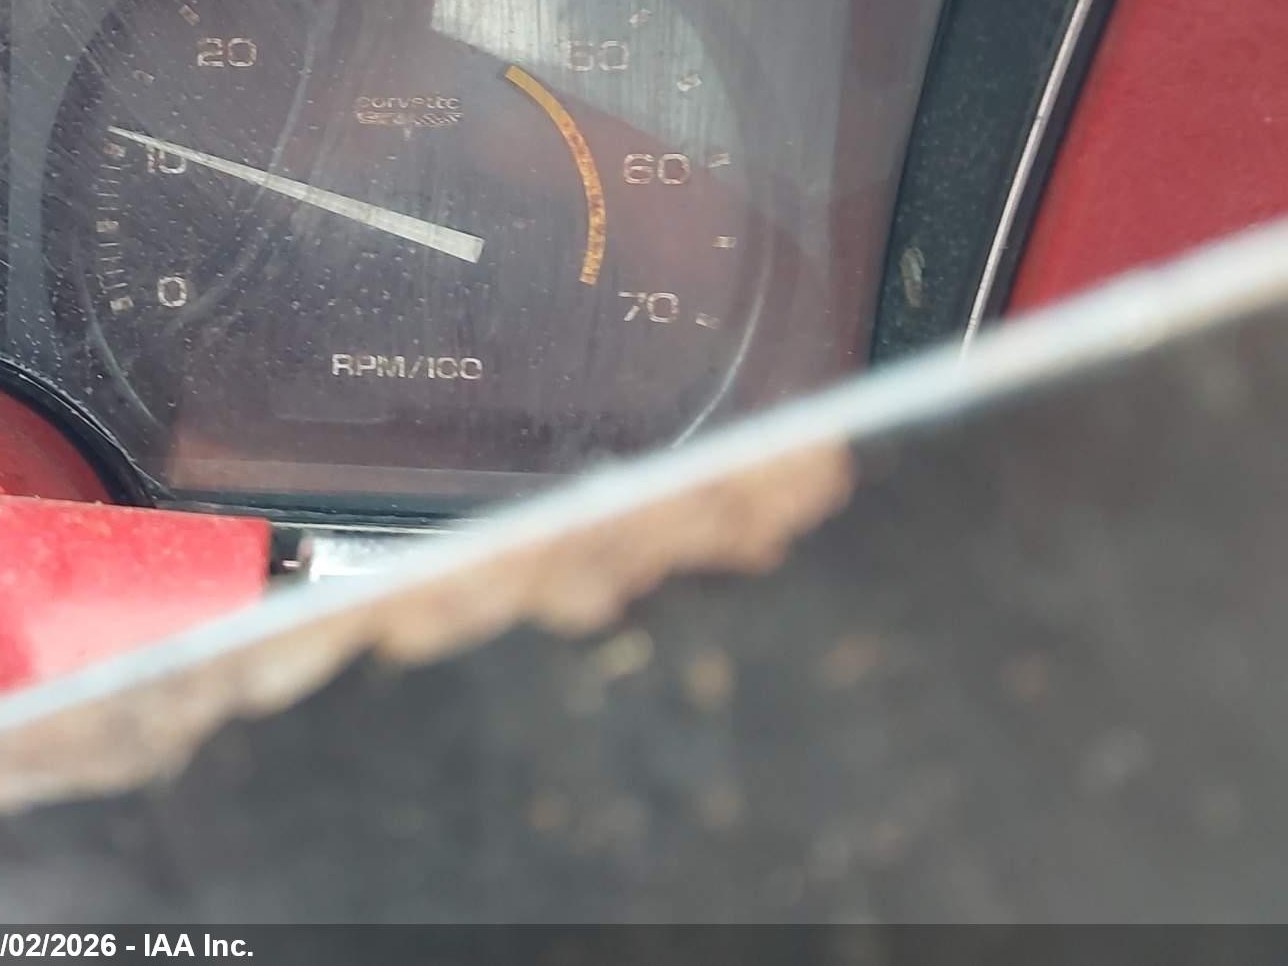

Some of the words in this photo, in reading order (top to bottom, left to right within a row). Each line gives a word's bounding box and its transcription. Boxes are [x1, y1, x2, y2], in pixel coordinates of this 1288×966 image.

[197, 38, 257, 68] 20
[146, 144, 188, 175] 10
[623, 153, 691, 185] 60
[157, 276, 188, 307] 0
[617, 292, 680, 324] 70
[331, 353, 484, 381] RPM/100
